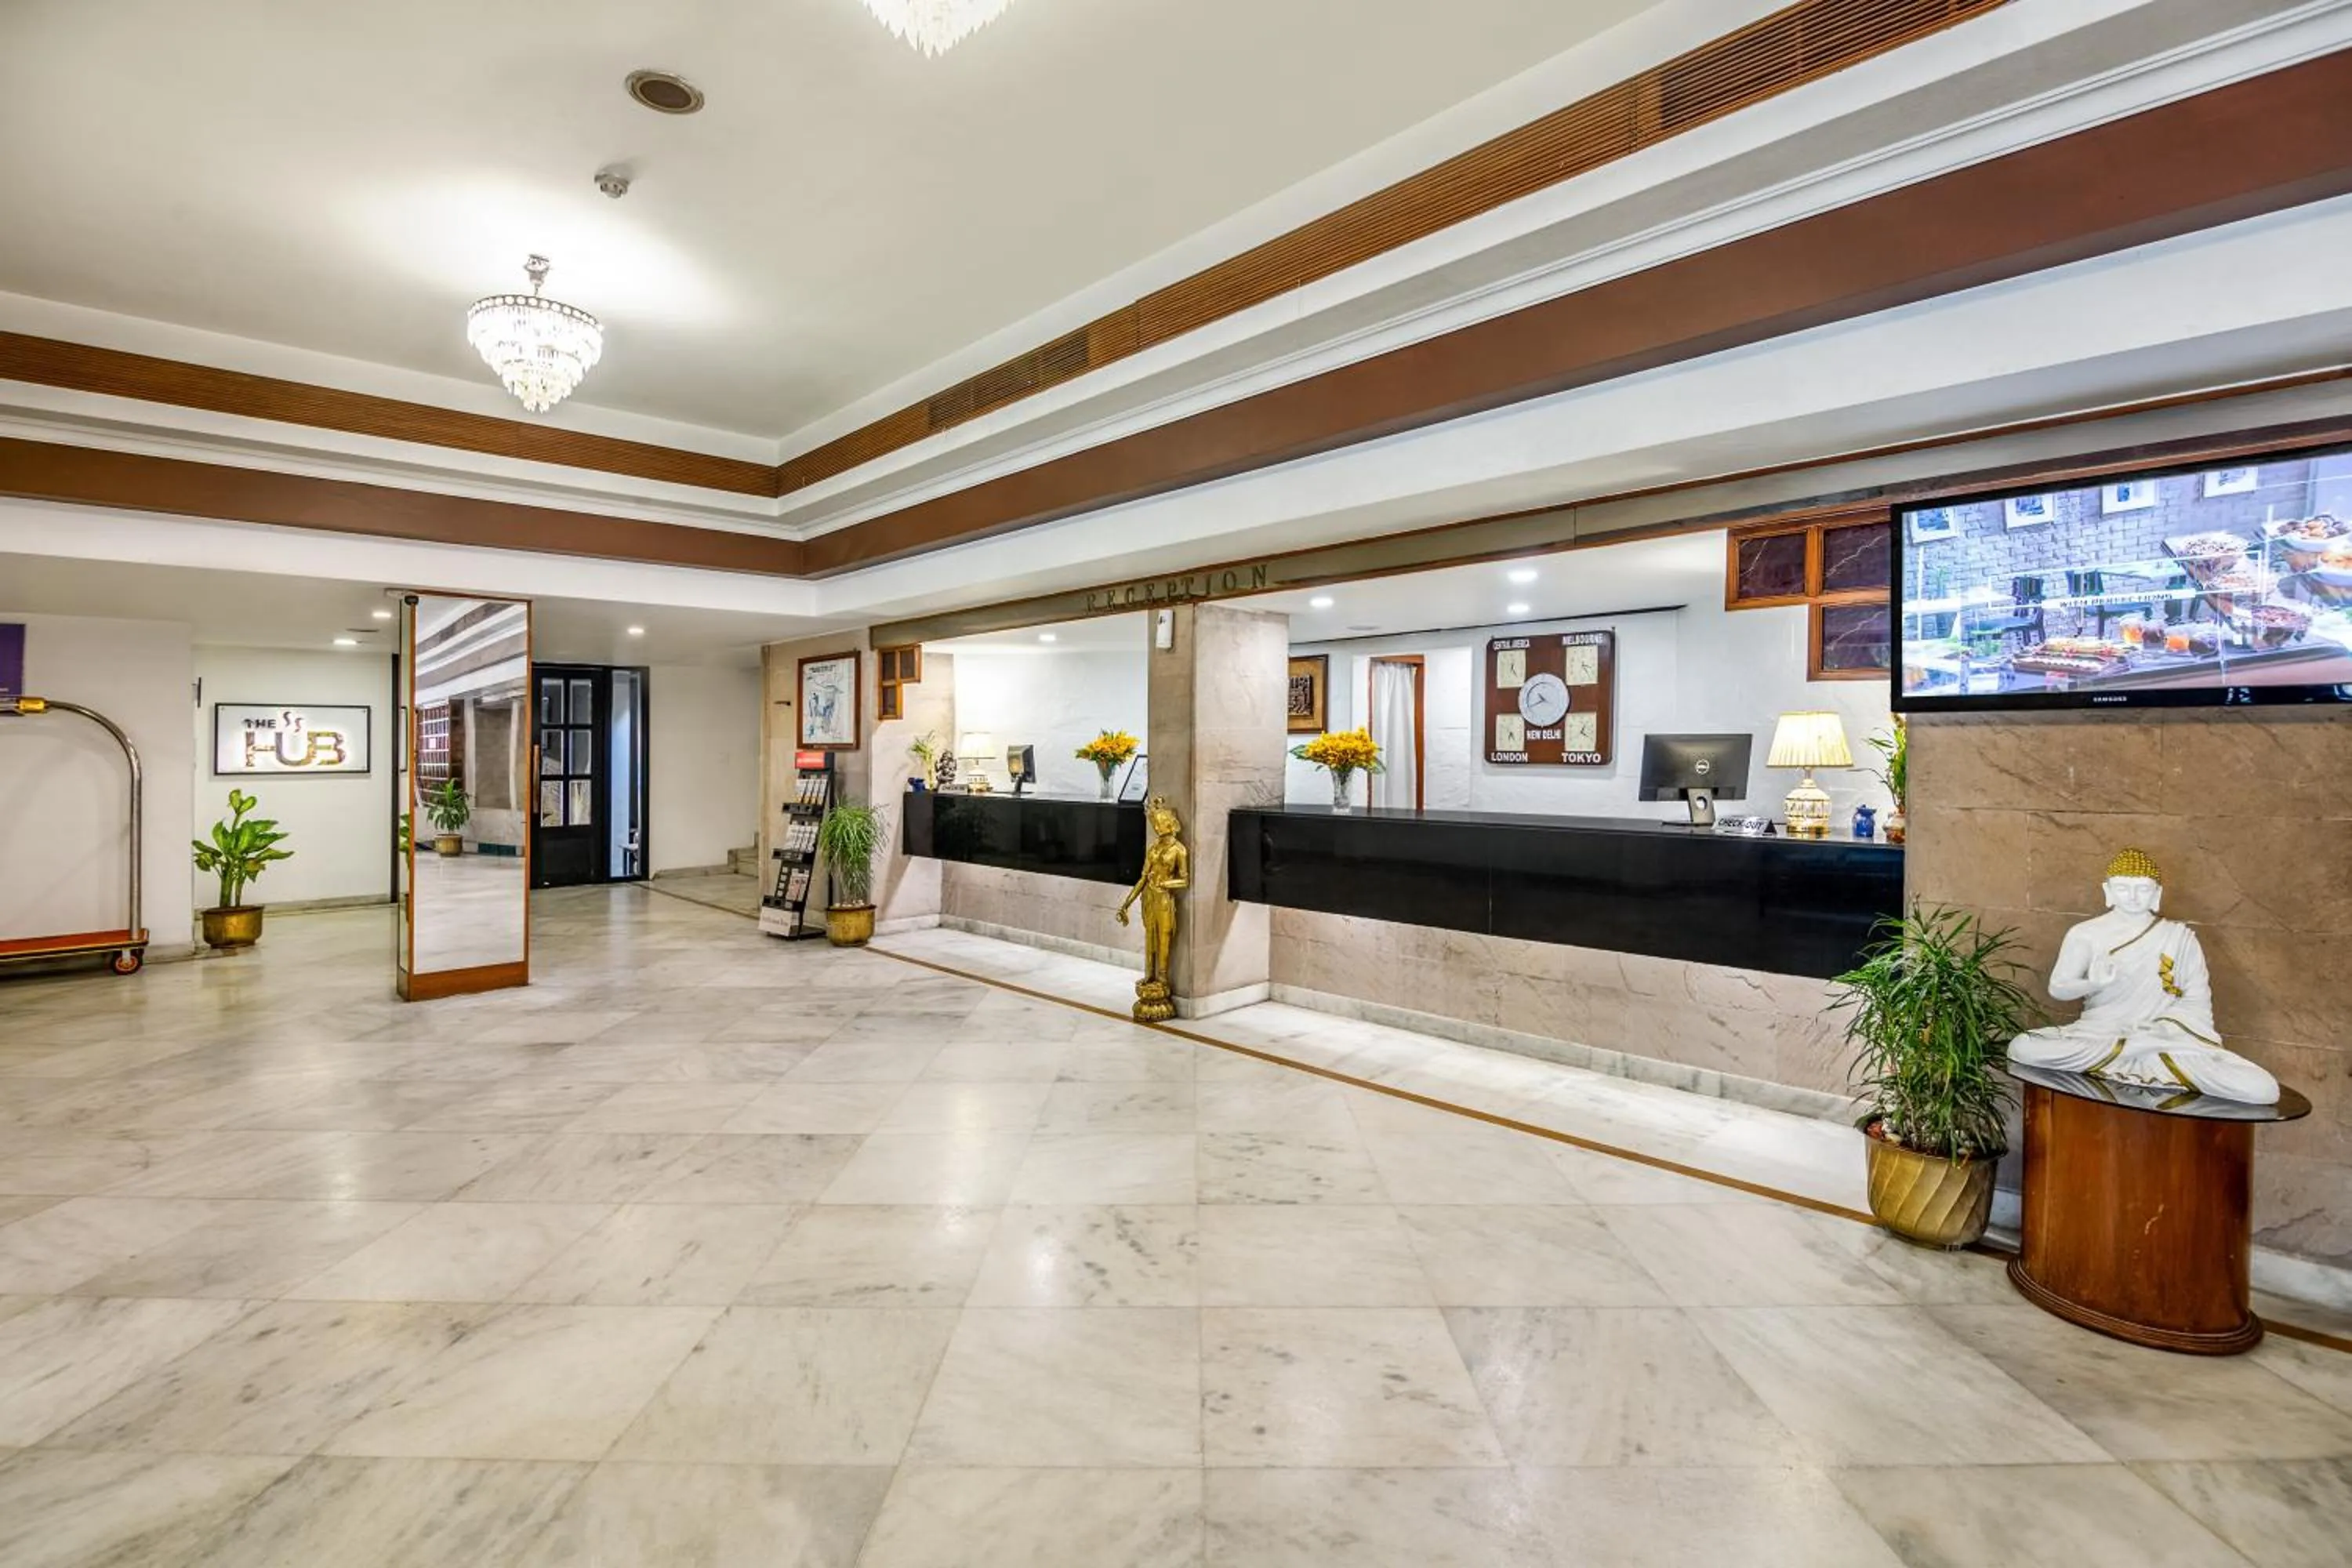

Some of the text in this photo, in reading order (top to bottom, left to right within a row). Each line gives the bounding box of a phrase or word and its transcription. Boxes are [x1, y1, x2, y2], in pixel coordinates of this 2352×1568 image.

[1085, 564, 1268, 613] RECEPTION
[1563, 632, 1605, 645] MELBOURNE
[241, 718, 277, 729] THE
[1526, 729, 1563, 740] NEW DELHI
[245, 731, 347, 768] HUB
[1490, 752, 1529, 762] LONDON
[1561, 753, 1602, 763] TOKYO
